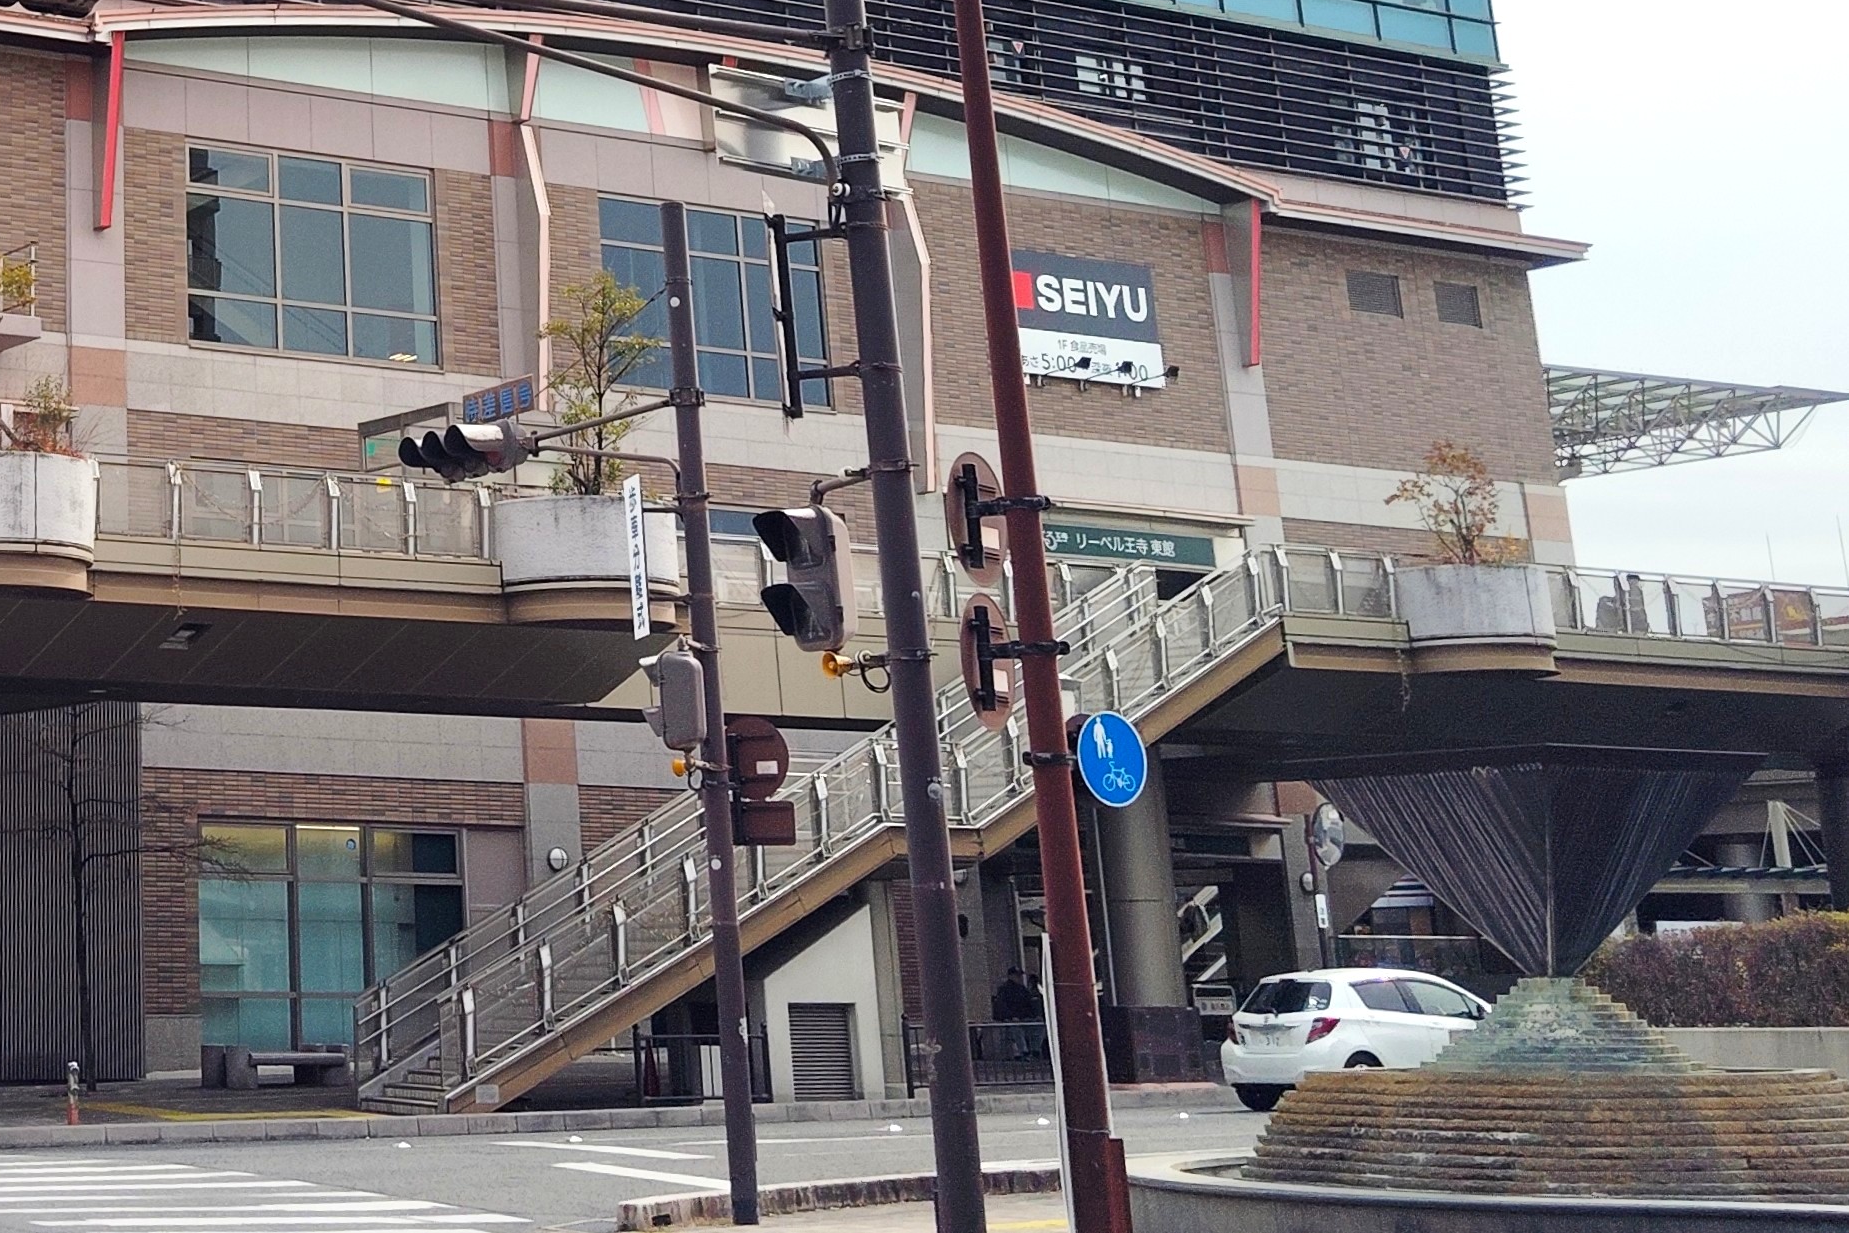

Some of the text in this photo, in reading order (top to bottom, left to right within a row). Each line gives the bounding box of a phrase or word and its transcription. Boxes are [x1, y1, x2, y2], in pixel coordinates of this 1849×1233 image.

[1036, 274, 1148, 322] SEIYU
[1076, 532, 1149, 556] リーベル王寺
